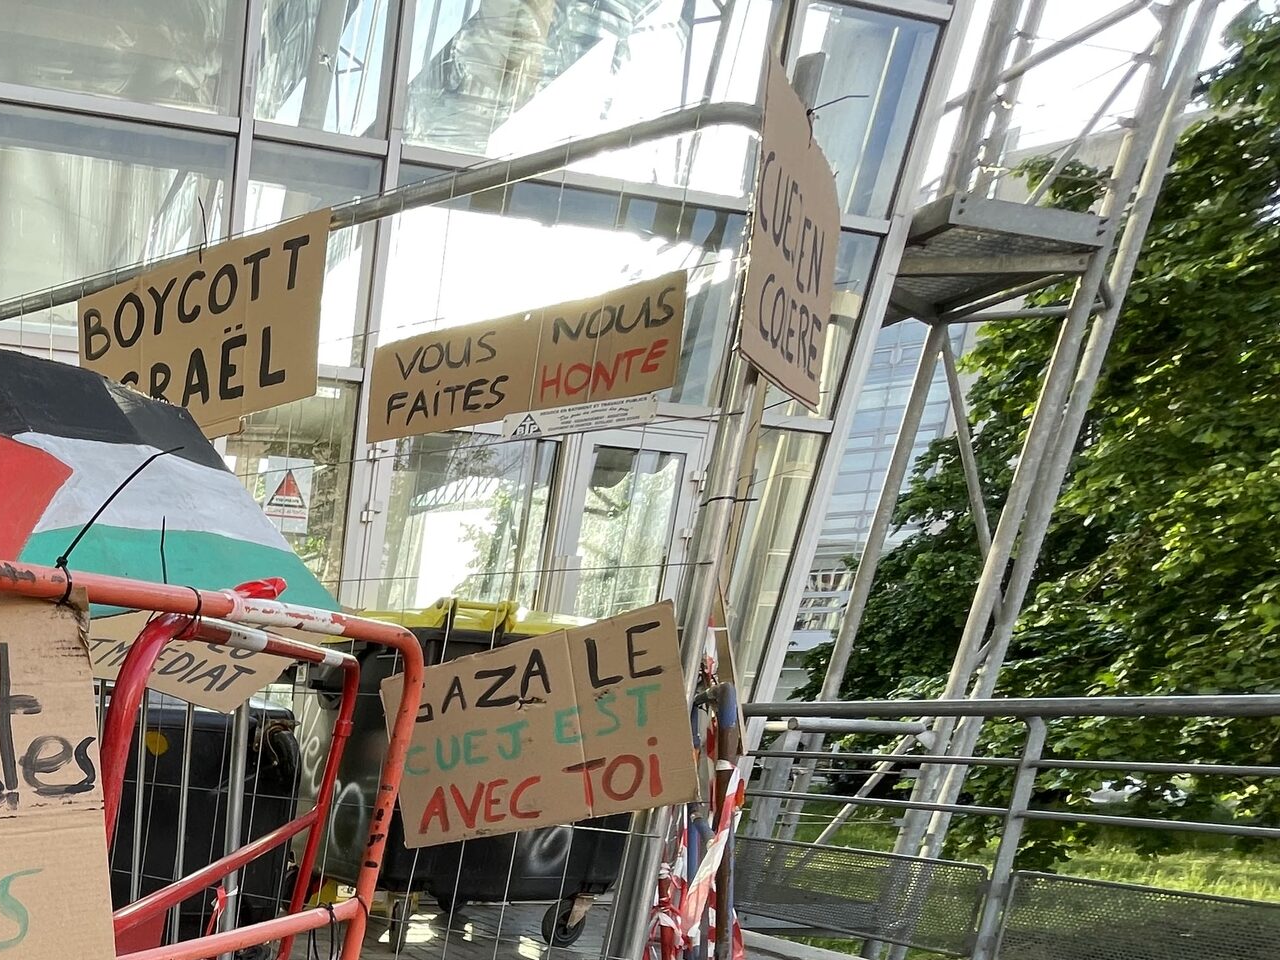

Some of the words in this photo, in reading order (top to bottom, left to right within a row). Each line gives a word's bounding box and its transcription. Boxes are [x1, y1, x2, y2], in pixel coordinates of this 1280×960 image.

[84, 234, 310, 361] BOYCOTT
[102, 324, 286, 407] RAËL
[395, 331, 498, 380] VOUS
[551, 287, 676, 344] NOUS
[540, 338, 670, 402] HONTE
[516, 420, 539, 436] BTP
[584, 621, 665, 689] LE
[553, 684, 662, 745] EST
[418, 776, 541, 835] AVEC
